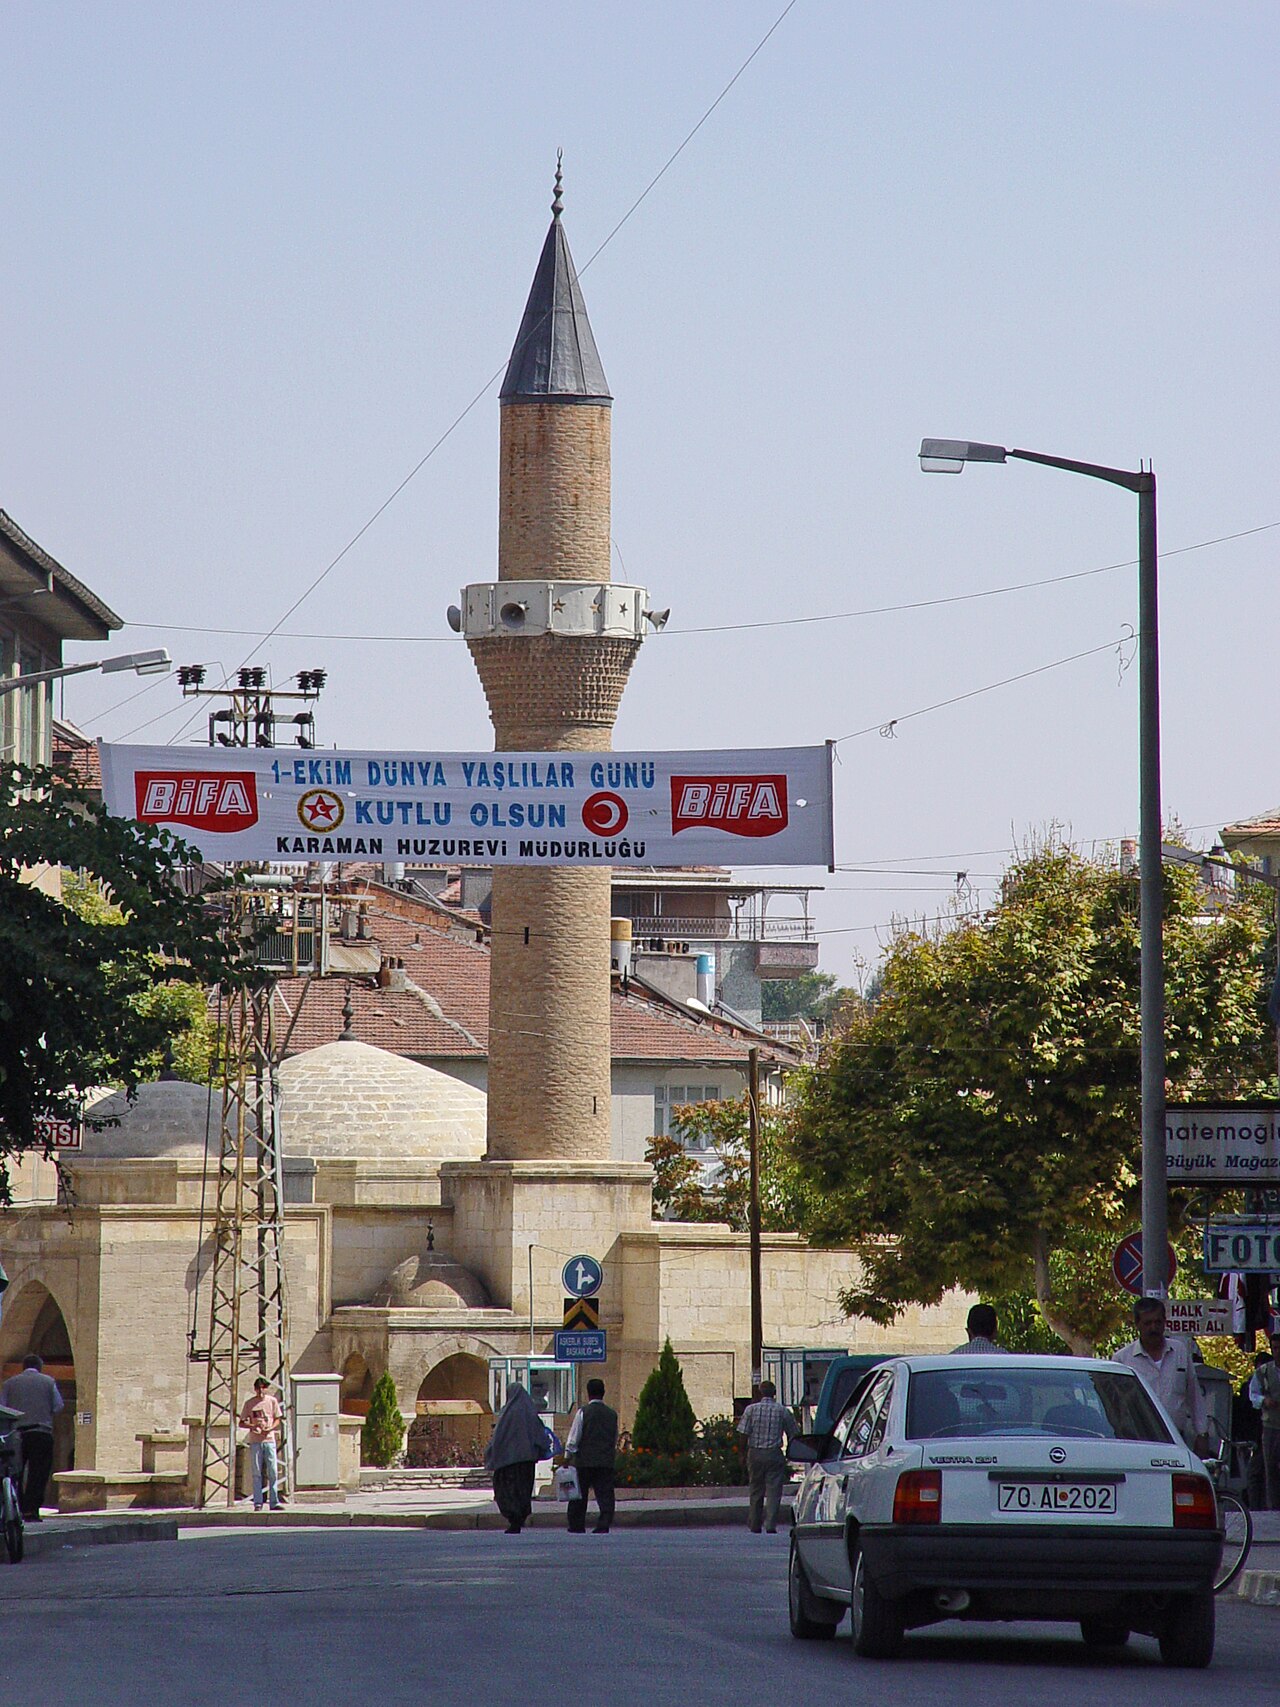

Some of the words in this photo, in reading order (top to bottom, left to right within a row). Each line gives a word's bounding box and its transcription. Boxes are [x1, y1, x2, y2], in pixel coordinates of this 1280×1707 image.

[368, 761, 446, 787] DÜNYA
[462, 763, 575, 791] YAŞLILAR
[590, 762, 655, 788] GÜNÜ
[356, 801, 451, 826] KUTLU
[470, 803, 566, 828] OLSUN
[276, 837, 383, 855] KARAMAN
[1225, 1155, 1280, 1171] Mağaz
[1172, 1305, 1203, 1317] HALK
[929, 1456, 974, 1464] VECTRA
[1151, 1459, 1185, 1468] OPEL
